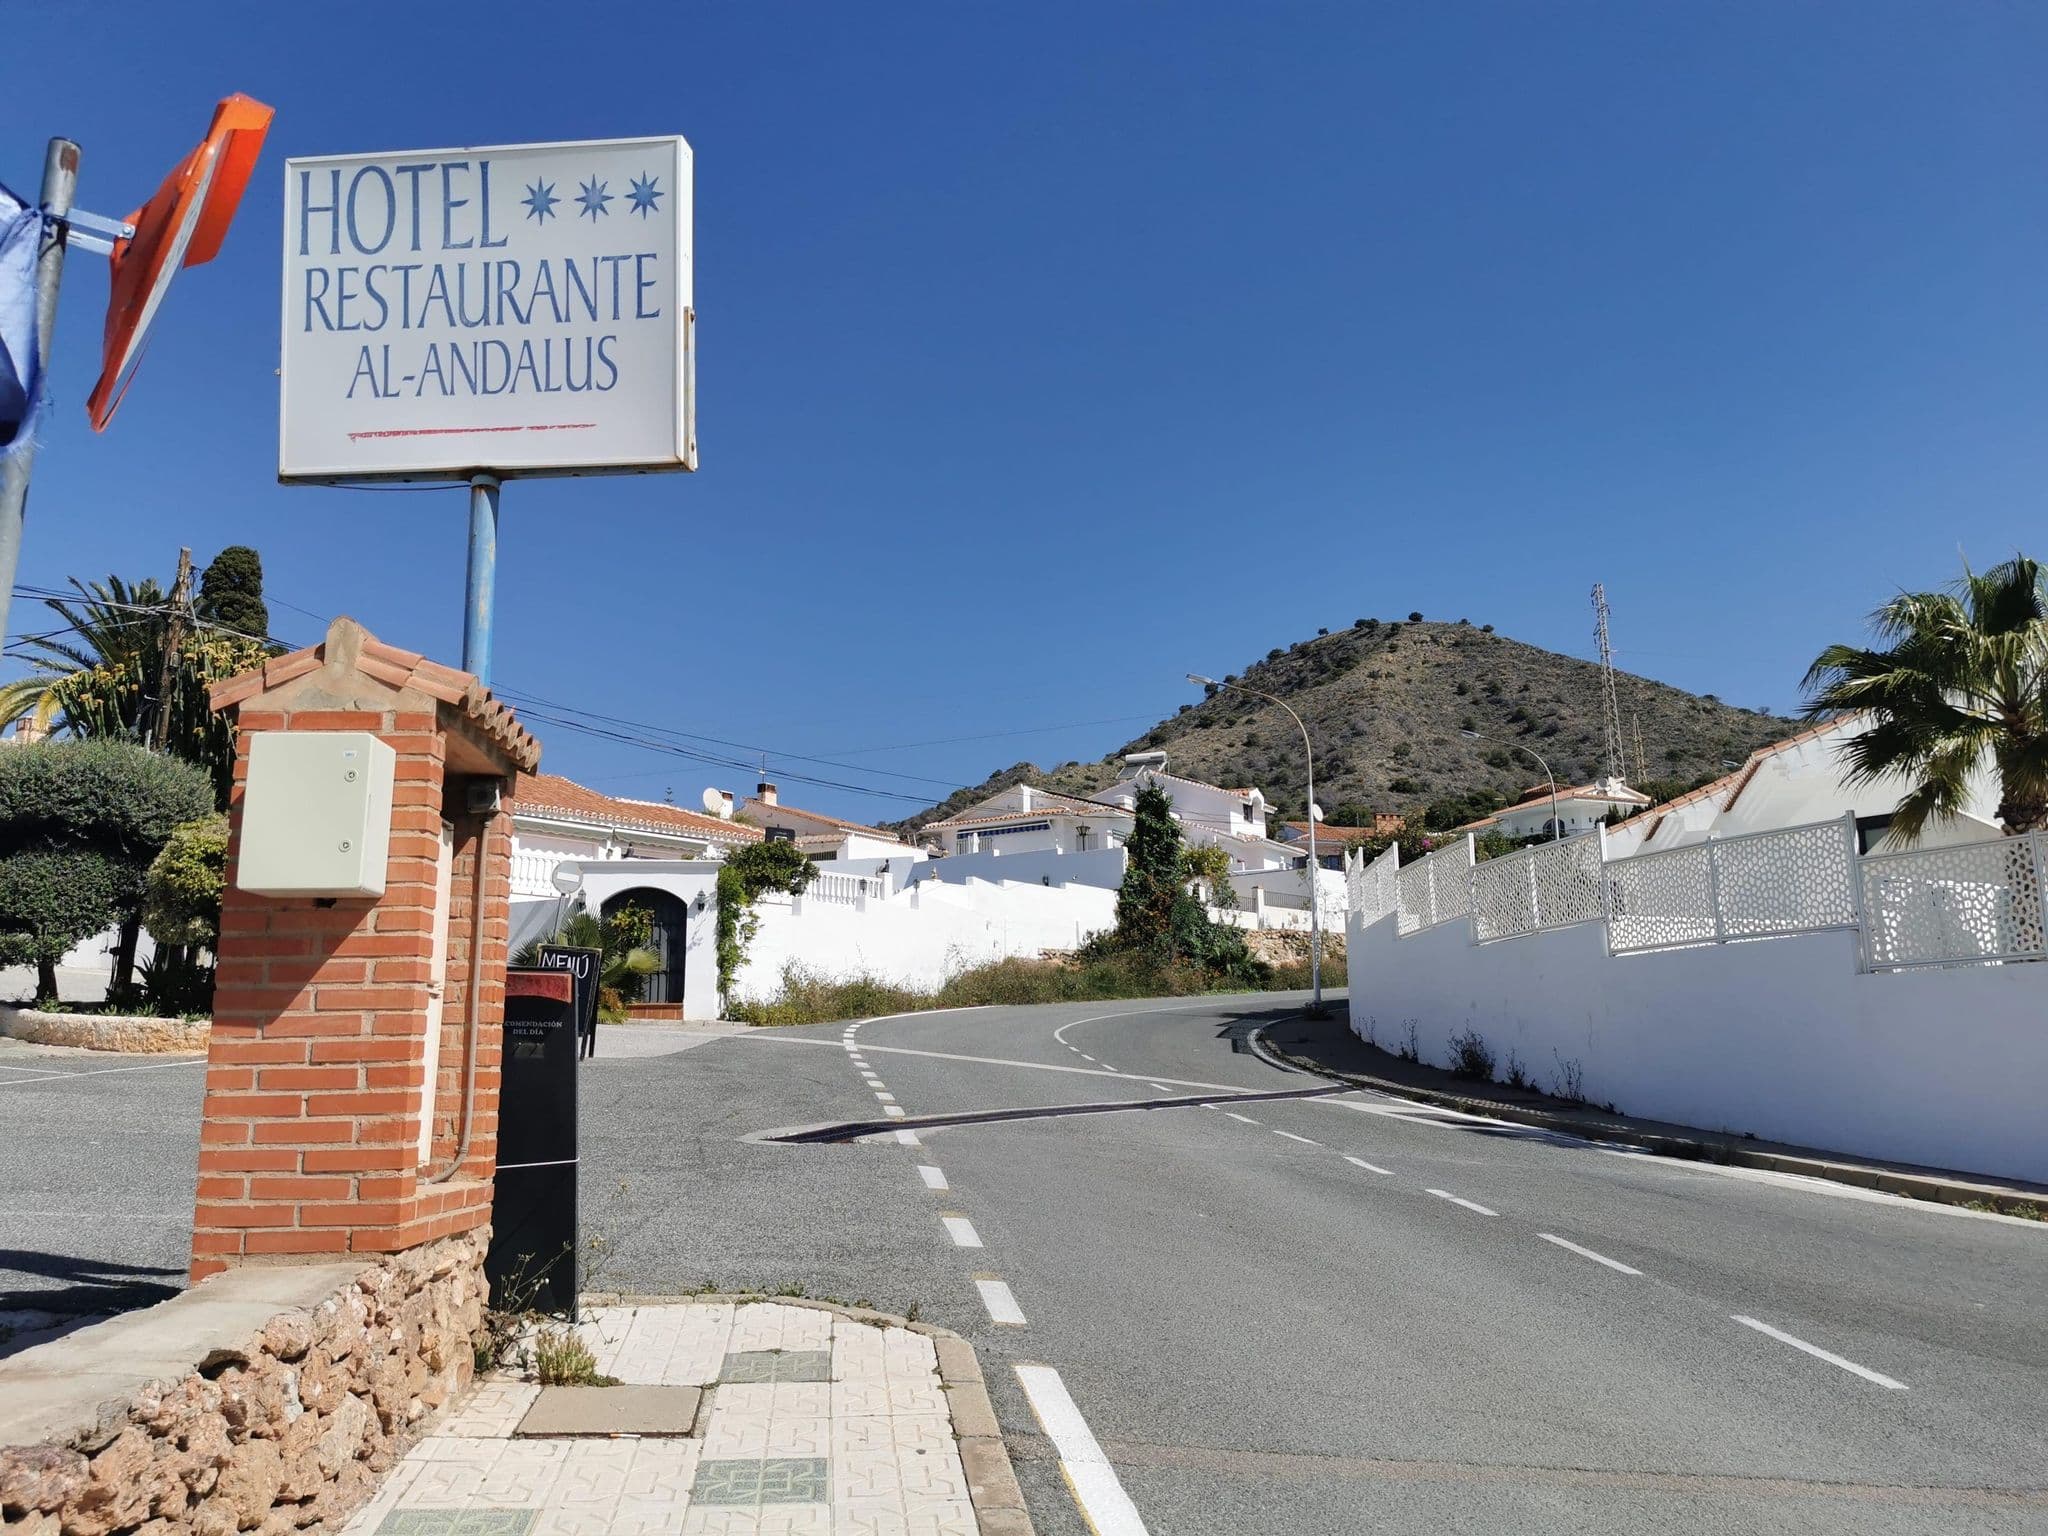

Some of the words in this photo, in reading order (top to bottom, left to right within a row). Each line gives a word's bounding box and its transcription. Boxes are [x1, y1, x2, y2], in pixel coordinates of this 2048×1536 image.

[299, 161, 508, 256] HOTEL
[304, 253, 660, 332] RESTAURANTE
[346, 335, 618, 399] AL-ANDALUS
[541, 952, 589, 979] MENÚ
[505, 1020, 563, 1028] COMENDACIÓN
